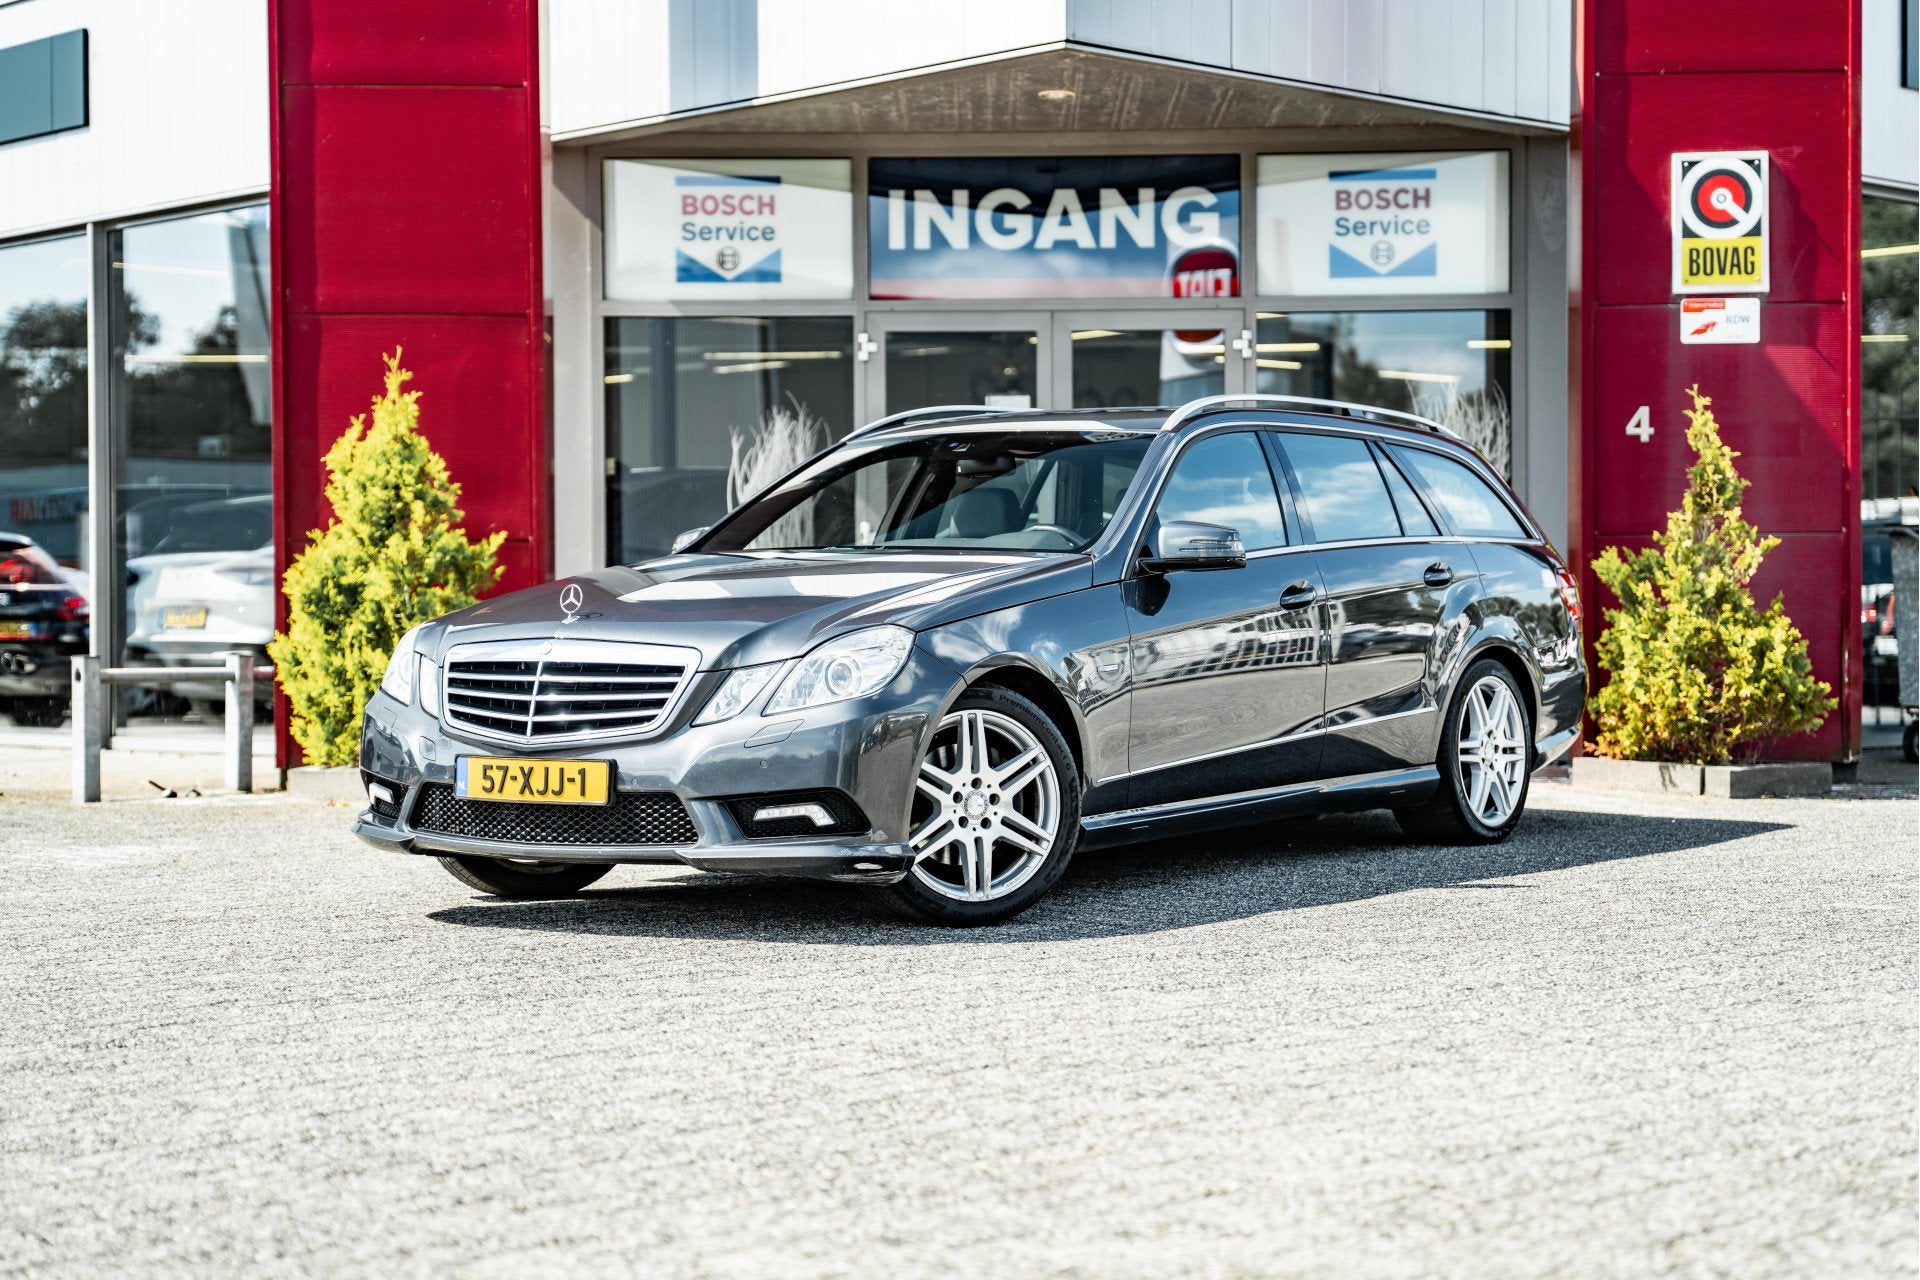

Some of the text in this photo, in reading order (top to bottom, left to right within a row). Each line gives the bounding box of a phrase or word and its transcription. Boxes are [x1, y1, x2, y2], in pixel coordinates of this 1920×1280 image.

[681, 194, 776, 216] BOSCH
[1335, 187, 1431, 211] BOSCH
[681, 221, 776, 241] Service
[887, 186, 1220, 251] INGANG
[1335, 214, 1431, 236] Service
[1688, 247, 1756, 277] BOVAG
[1625, 406, 1655, 443] 4
[482, 764, 586, 797] 57-XJJ-1
